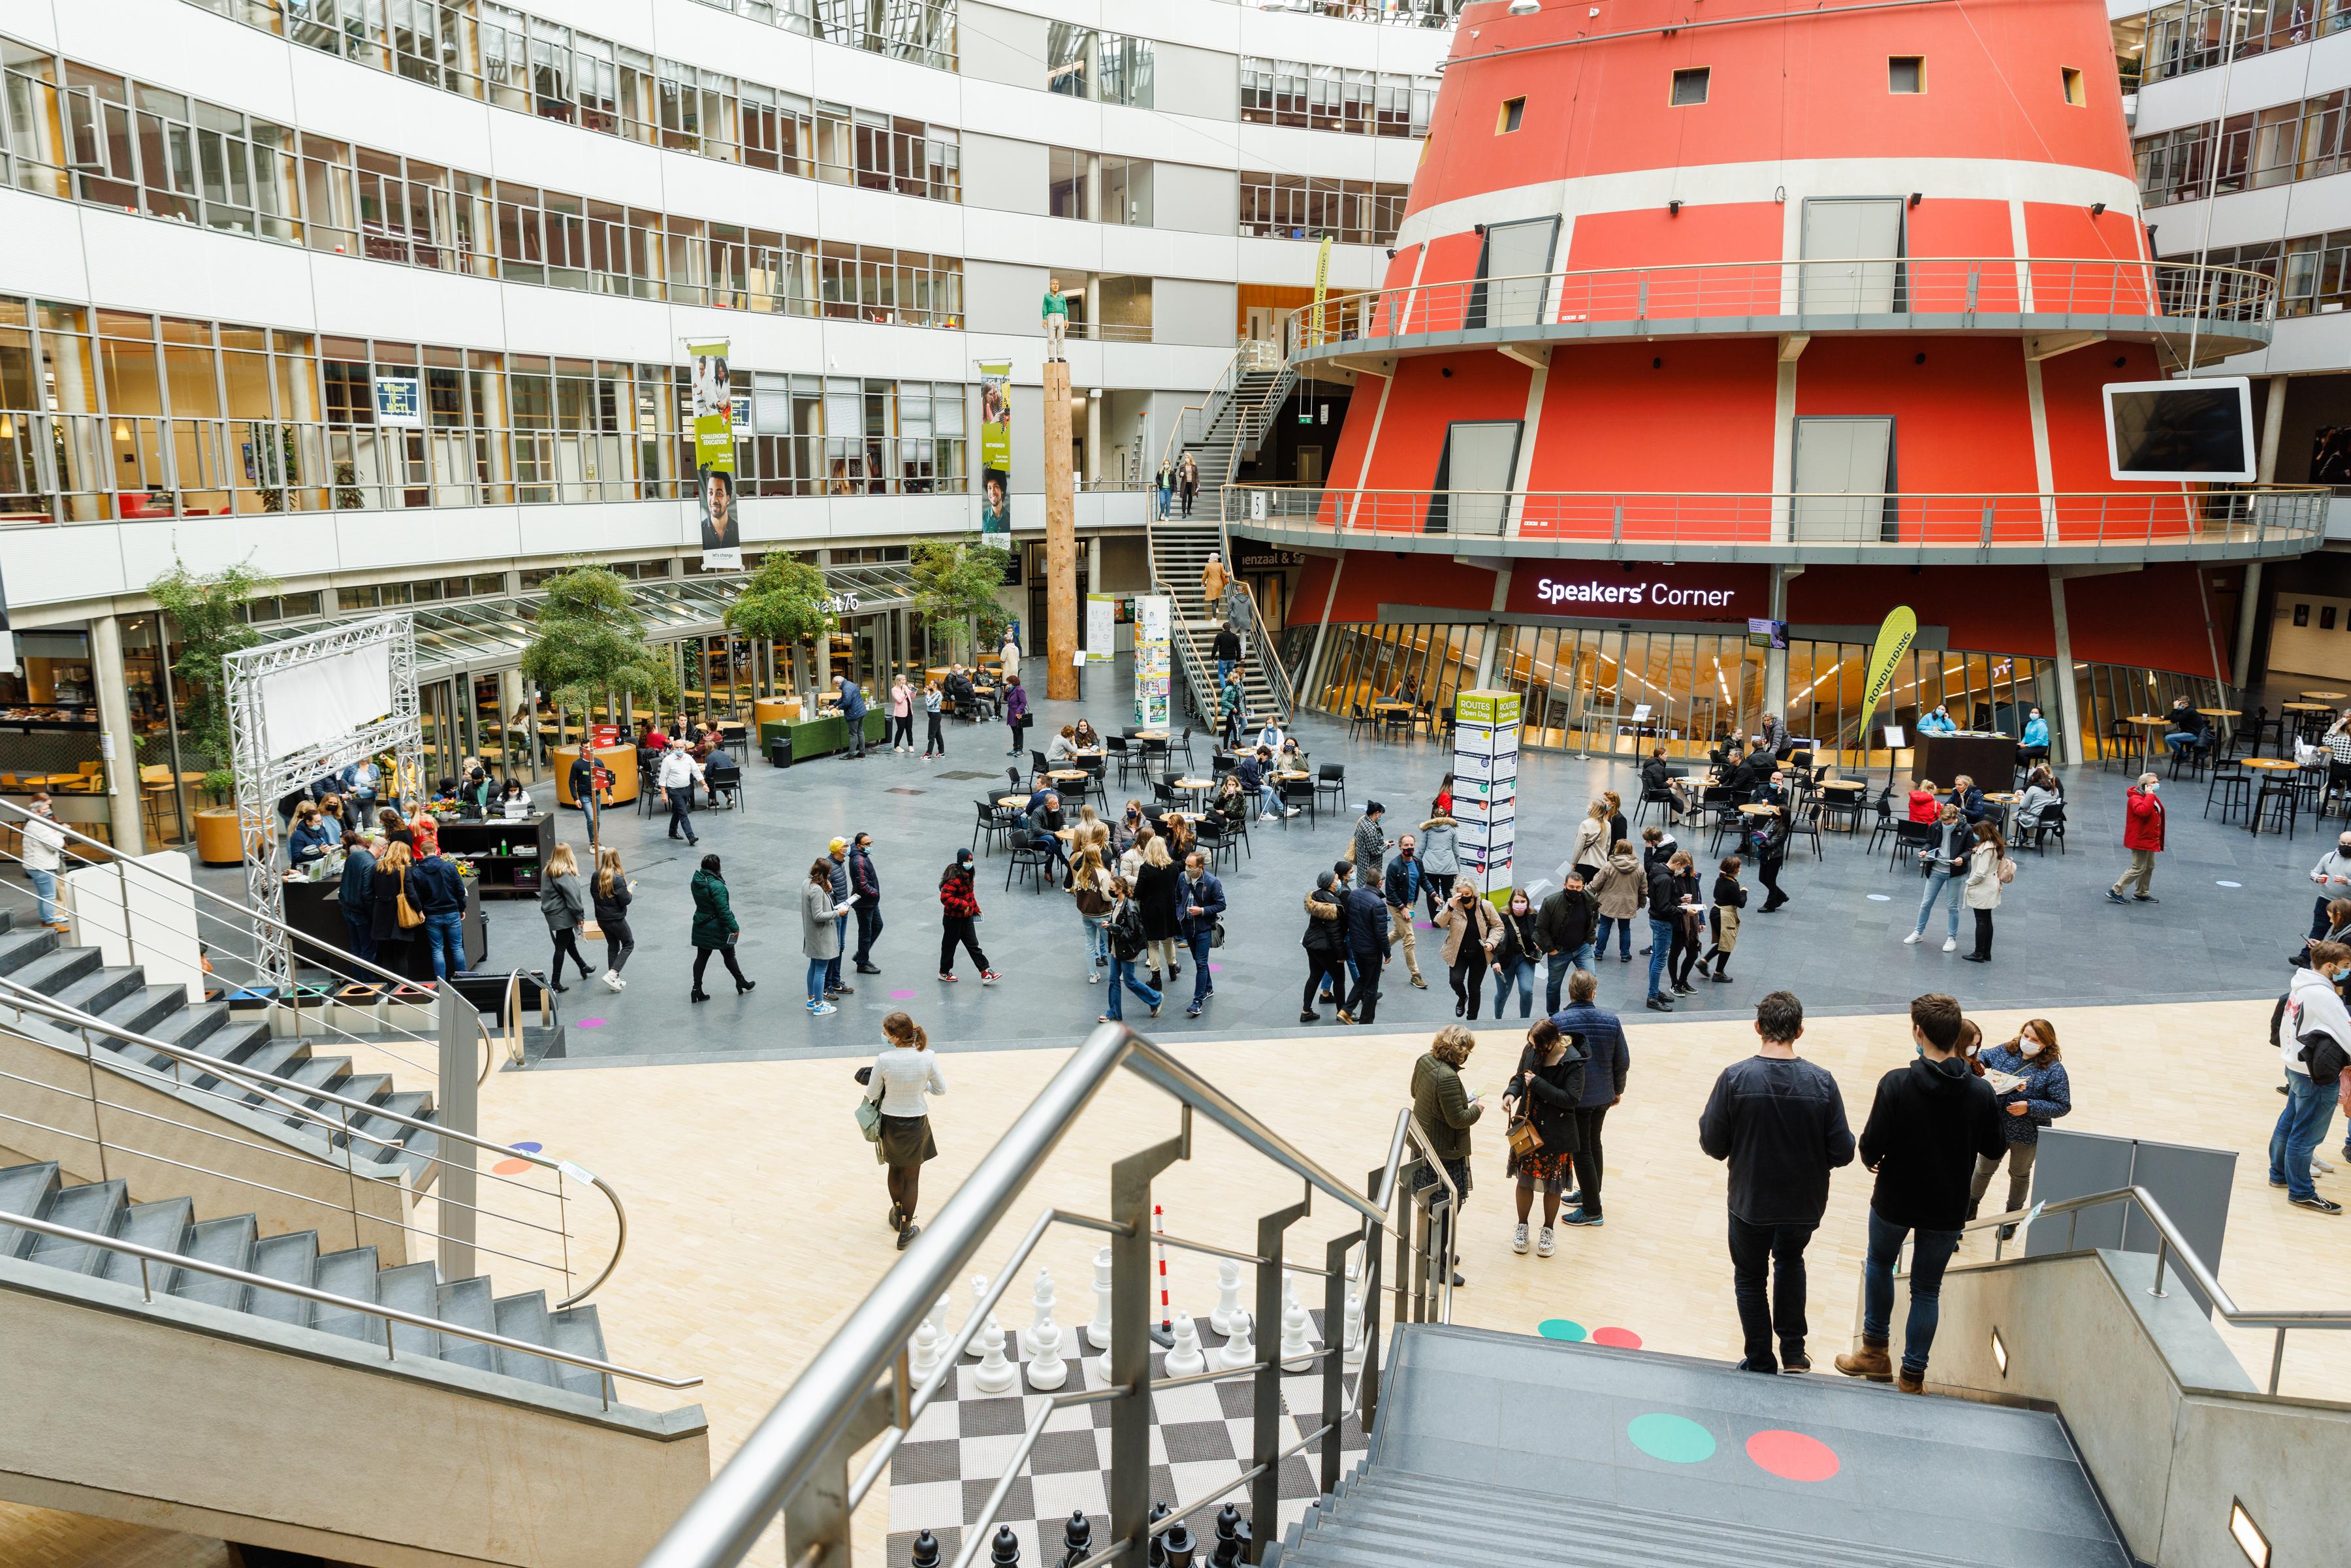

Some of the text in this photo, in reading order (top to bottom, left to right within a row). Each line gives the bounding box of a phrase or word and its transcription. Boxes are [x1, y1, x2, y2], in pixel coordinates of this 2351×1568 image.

[1255, 496, 1260, 515] 5
[1281, 552, 1289, 564] &
[1537, 579, 1735, 606] Speakers' Corner
[1868, 632, 1910, 704] RONDLEIDING
[1461, 700, 1490, 711] ROUTES
[1499, 701, 1518, 711] ROUTES
[1460, 709, 1490, 720] Open Dag
